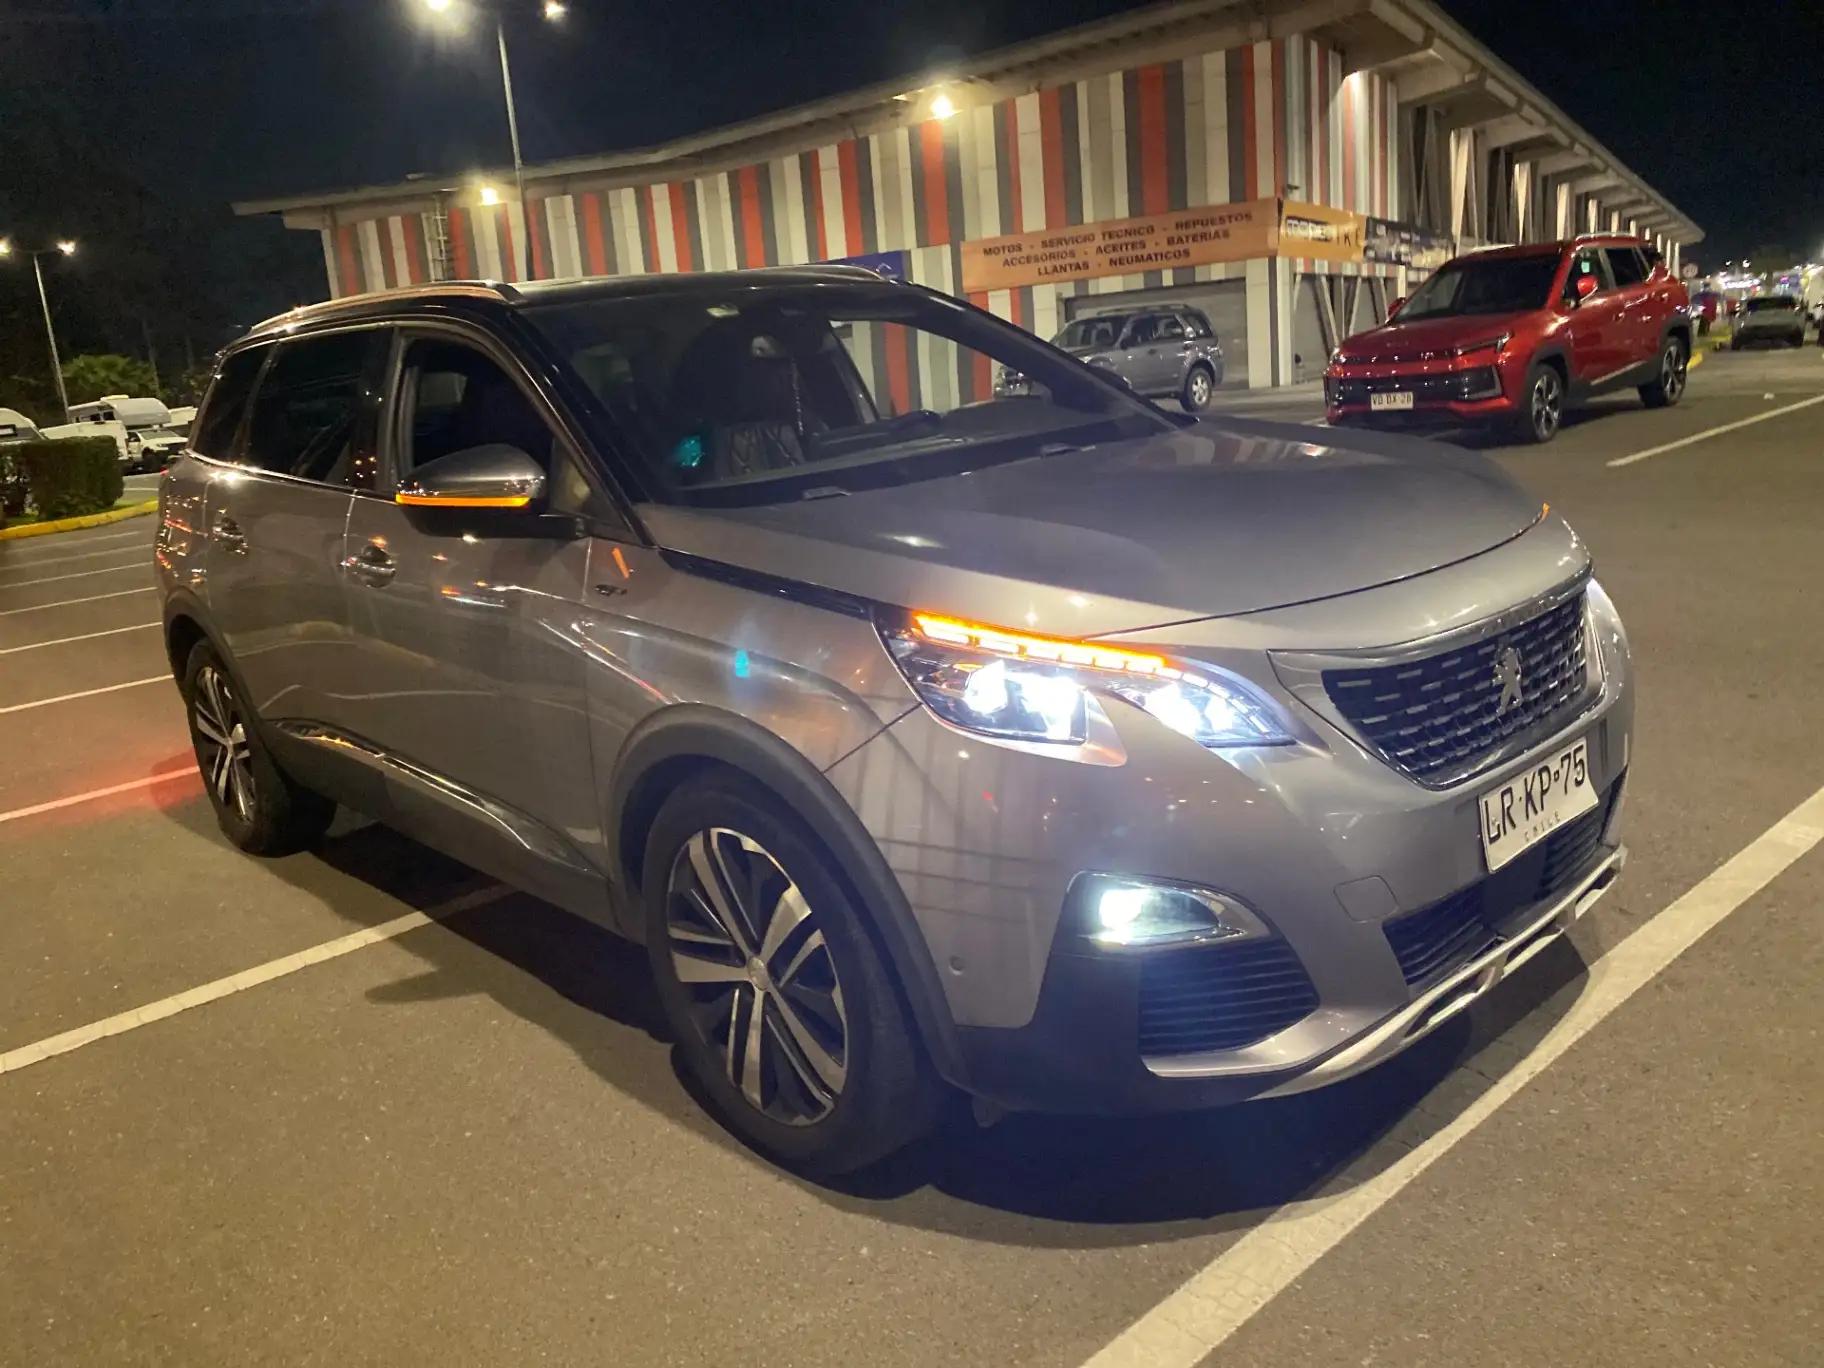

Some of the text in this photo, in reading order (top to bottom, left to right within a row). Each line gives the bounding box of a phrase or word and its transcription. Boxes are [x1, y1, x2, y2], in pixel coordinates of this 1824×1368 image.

[983, 212, 1253, 256] MOTOS SERVICIO TECNICO REPUESTOS
[1002, 229, 1231, 268] ACCESORIOS ACEITES BATERIAS
[1037, 248, 1191, 276] LLANTAS NEUMATICOS
